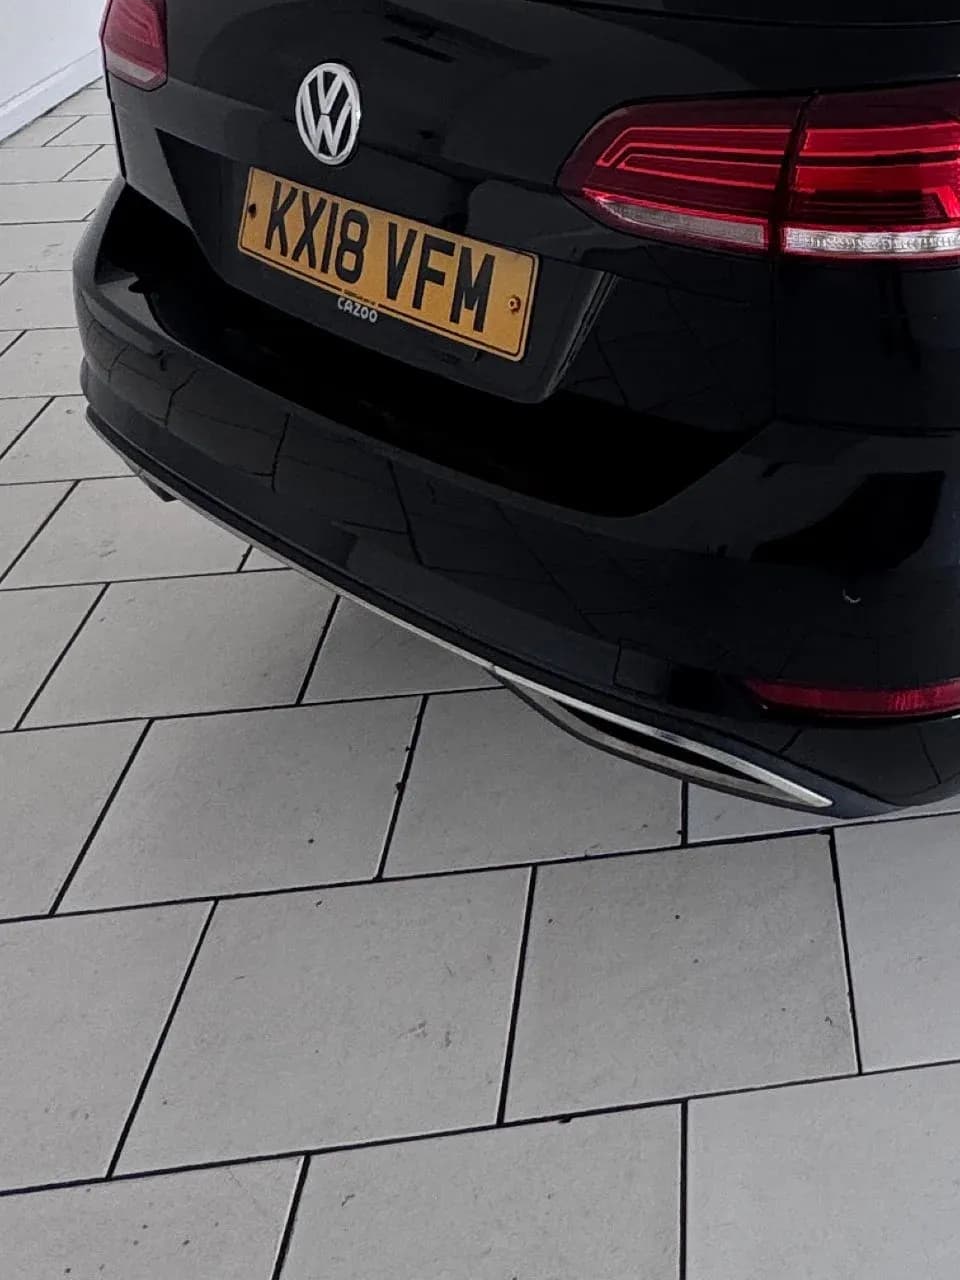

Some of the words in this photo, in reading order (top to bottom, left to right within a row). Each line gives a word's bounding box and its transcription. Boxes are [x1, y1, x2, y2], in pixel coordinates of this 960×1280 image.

[264, 181, 370, 284] KX18
[386, 222, 496, 333] VFM
[337, 297, 378, 323] CAZOO
